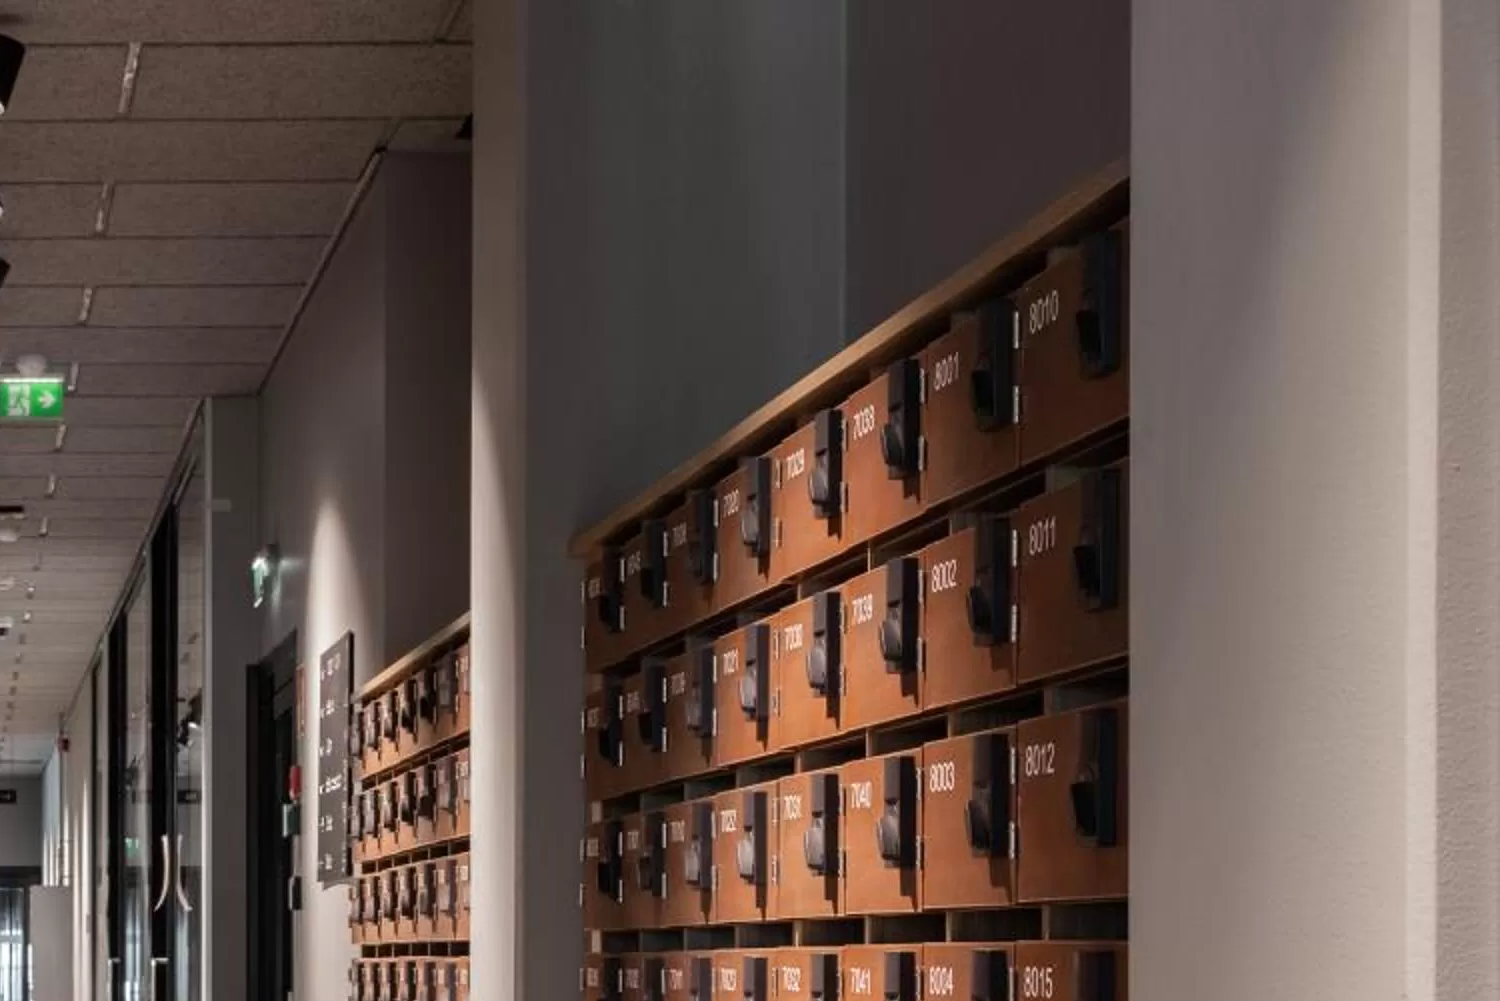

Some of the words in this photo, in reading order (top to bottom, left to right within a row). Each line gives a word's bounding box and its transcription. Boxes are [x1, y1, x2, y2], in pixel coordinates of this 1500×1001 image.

[1029, 289, 1059, 335] 8010
[1028, 515, 1056, 556] 8011
[930, 559, 957, 593] 8002
[1025, 742, 1056, 777] 8012
[928, 761, 956, 793] 8003
[849, 967, 873, 996] 7041
[928, 965, 954, 996] 8004
[1023, 965, 1055, 998] 8015
